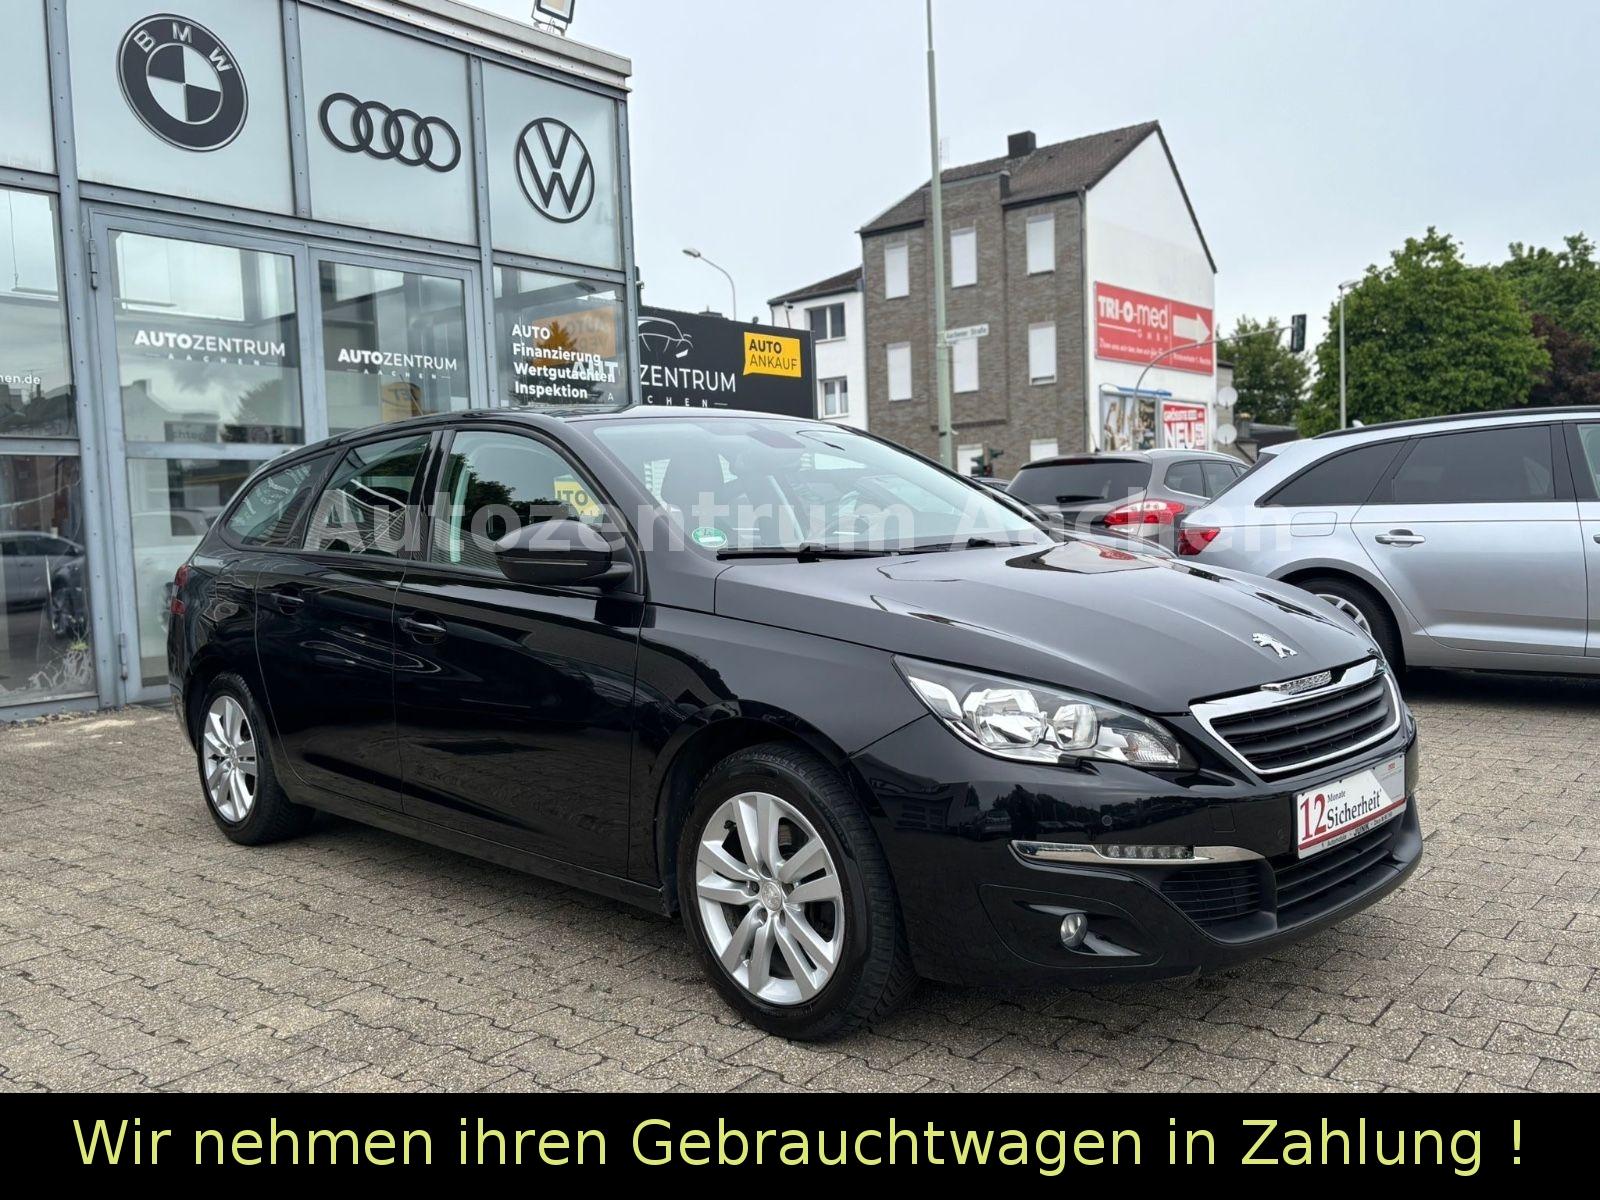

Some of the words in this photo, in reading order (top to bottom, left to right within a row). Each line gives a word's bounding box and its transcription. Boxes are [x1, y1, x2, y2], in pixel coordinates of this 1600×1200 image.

[133, 22, 233, 72] BMW
[512, 324, 551, 340] AUTO
[134, 330, 286, 357] AUTOZENTRUM
[512, 342, 601, 365] Finanzierung
[749, 338, 782, 354] AUTO
[168, 353, 260, 366] AACHEN
[337, 348, 458, 371] AUTOZENTRUM
[750, 354, 798, 371] ANKAUF
[514, 380, 588, 399] Inspektion
[1299, 793, 1327, 841] 12
[1326, 789, 1381, 830] Sicherheit
